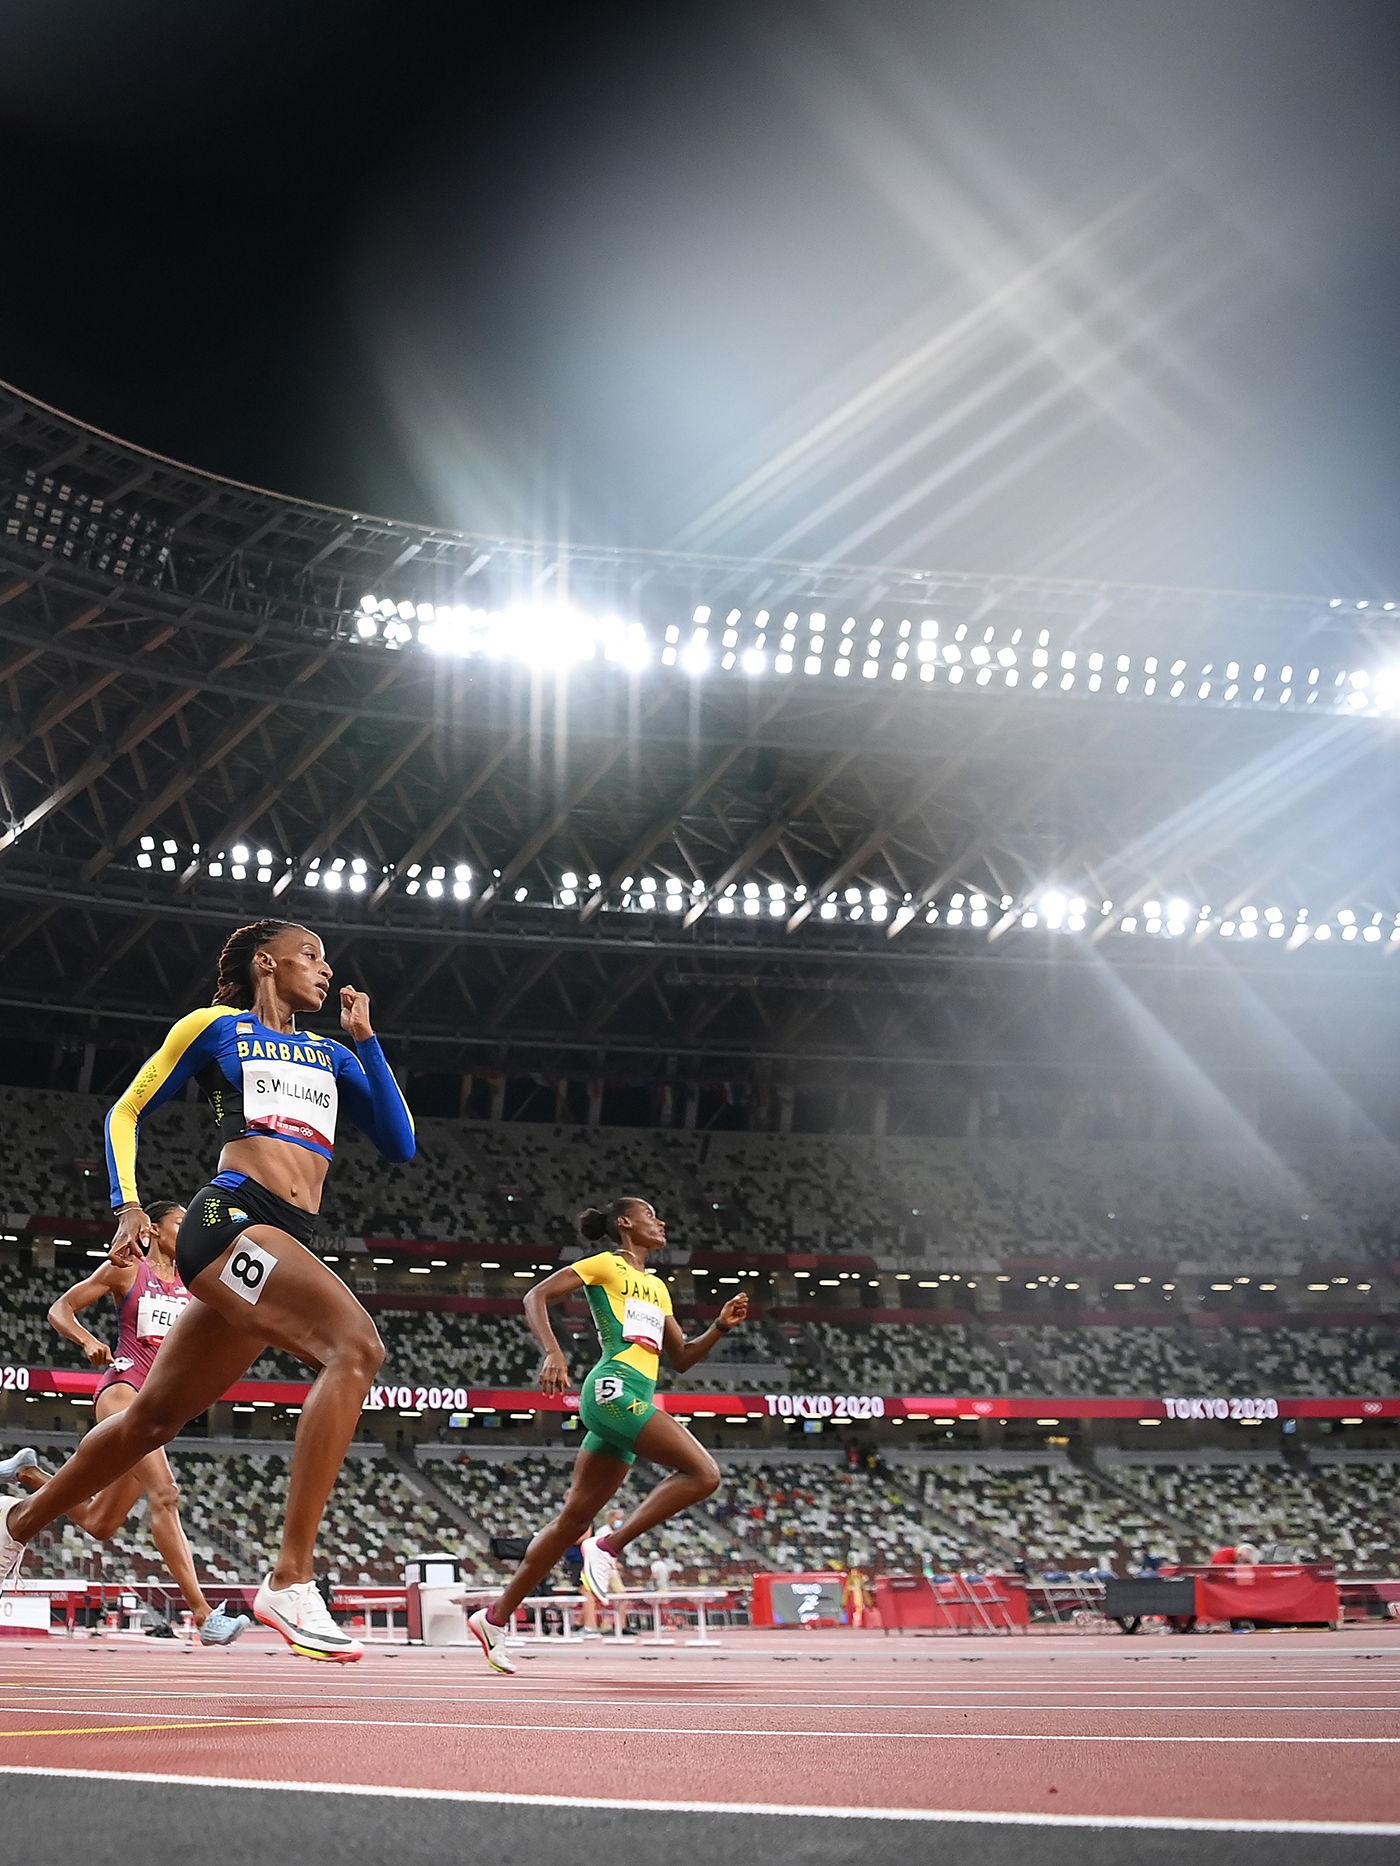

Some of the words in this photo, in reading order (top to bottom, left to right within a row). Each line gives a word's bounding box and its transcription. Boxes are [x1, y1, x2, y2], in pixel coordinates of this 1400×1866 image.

[237, 1040, 334, 1071] BARBADOS
[231, 1252, 264, 1288] 8
[152, 1309, 179, 1326] FEL
[363, 1385, 412, 1408] KYO
[415, 1387, 468, 1409] 2020
[601, 1380, 616, 1398] 5
[764, 1395, 833, 1417] TOKYO
[834, 1395, 885, 1417] 2020
[1162, 1397, 1229, 1419] TOKYO
[1228, 1397, 1279, 1419] 2020
